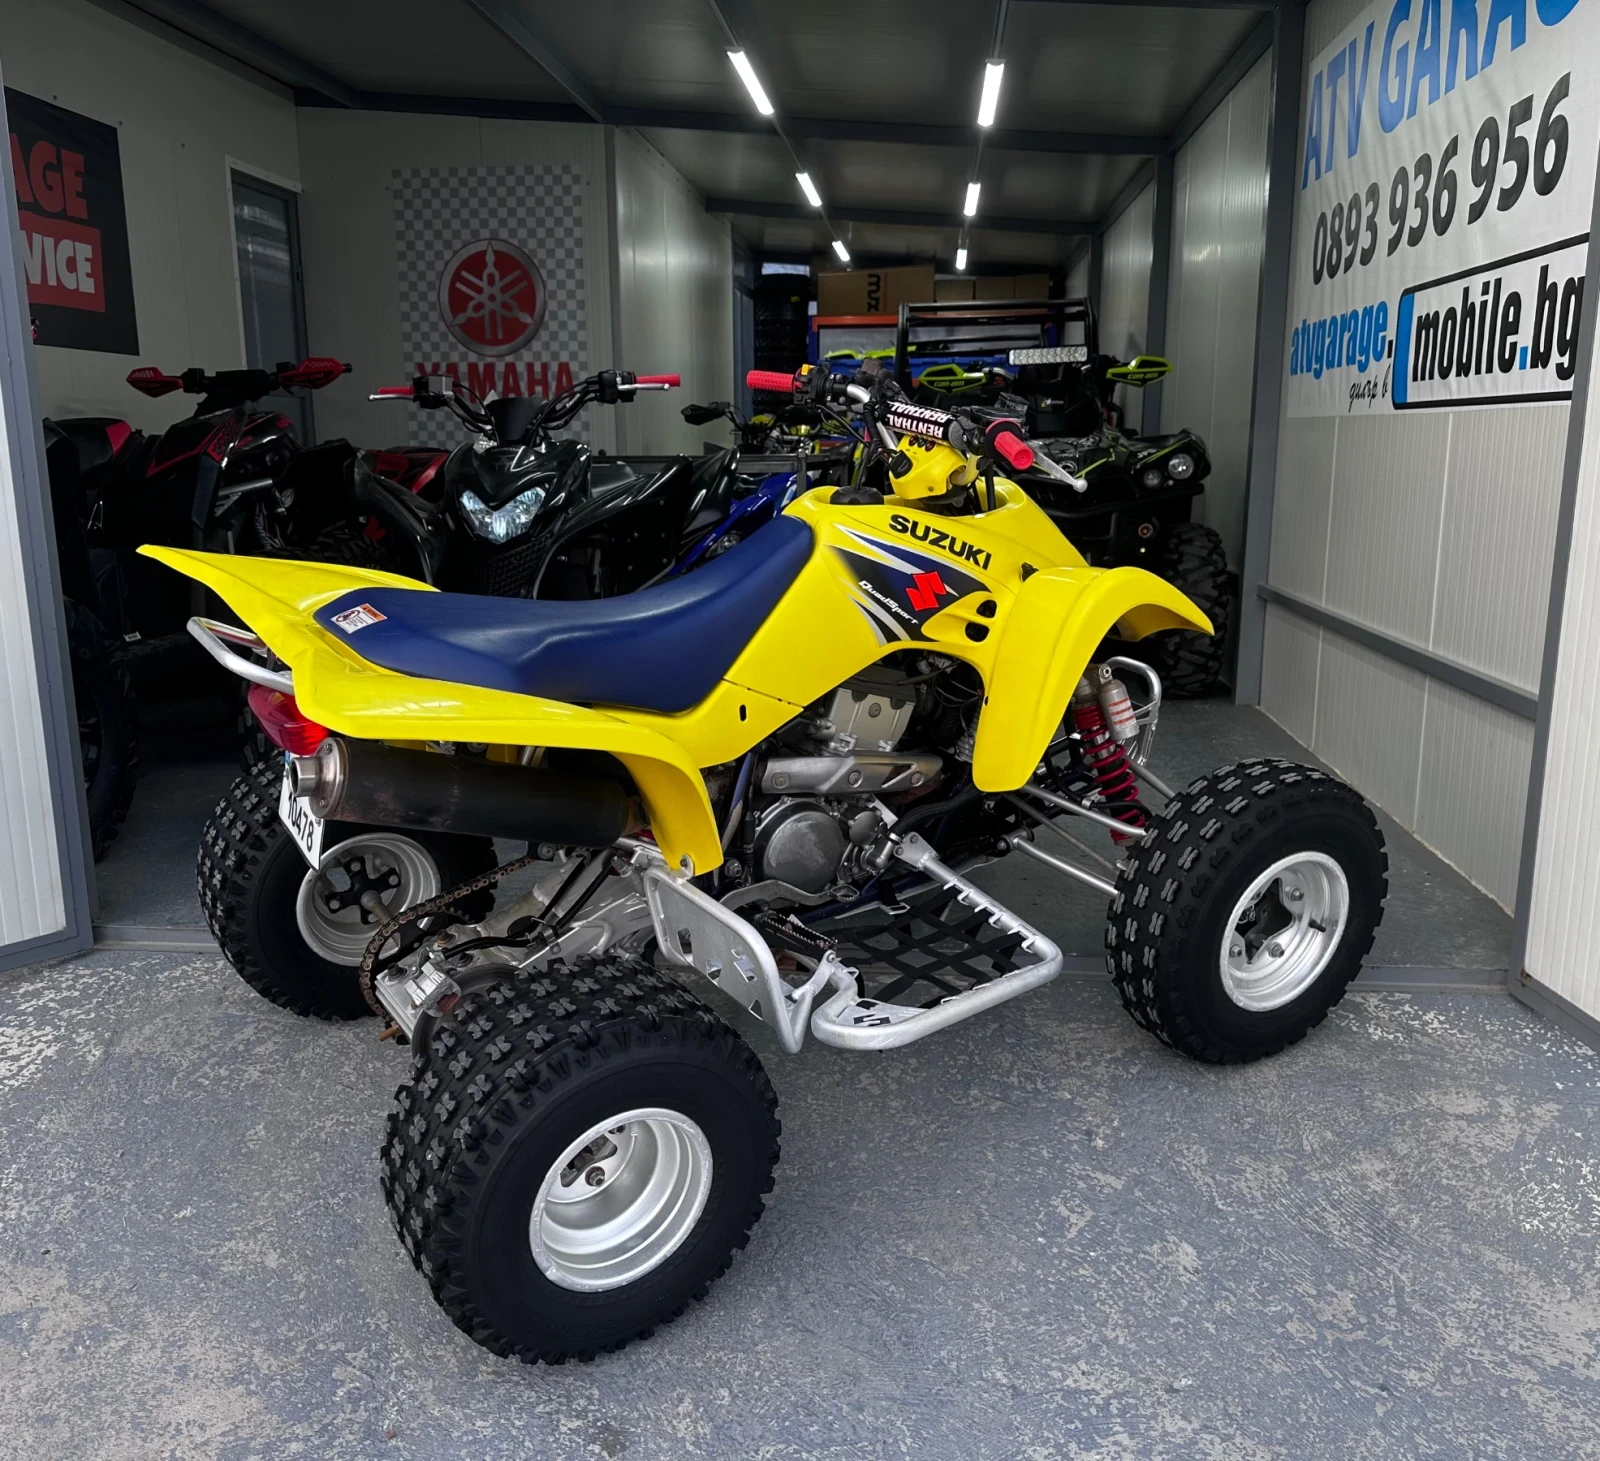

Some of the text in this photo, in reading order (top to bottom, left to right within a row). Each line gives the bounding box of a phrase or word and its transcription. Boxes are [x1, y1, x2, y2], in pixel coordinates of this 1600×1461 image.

[1302, 0, 1581, 190] ATV GARA
[1313, 71, 1571, 286] 0893 936 956
[1412, 264, 1586, 382] mobile.bg
[886, 413, 944, 438] RENTHAL
[887, 400, 955, 423] RENTHAL
[889, 514, 992, 571] SUZUKI
[858, 580, 919, 625] QuadSport
[288, 791, 314, 853] 10478
